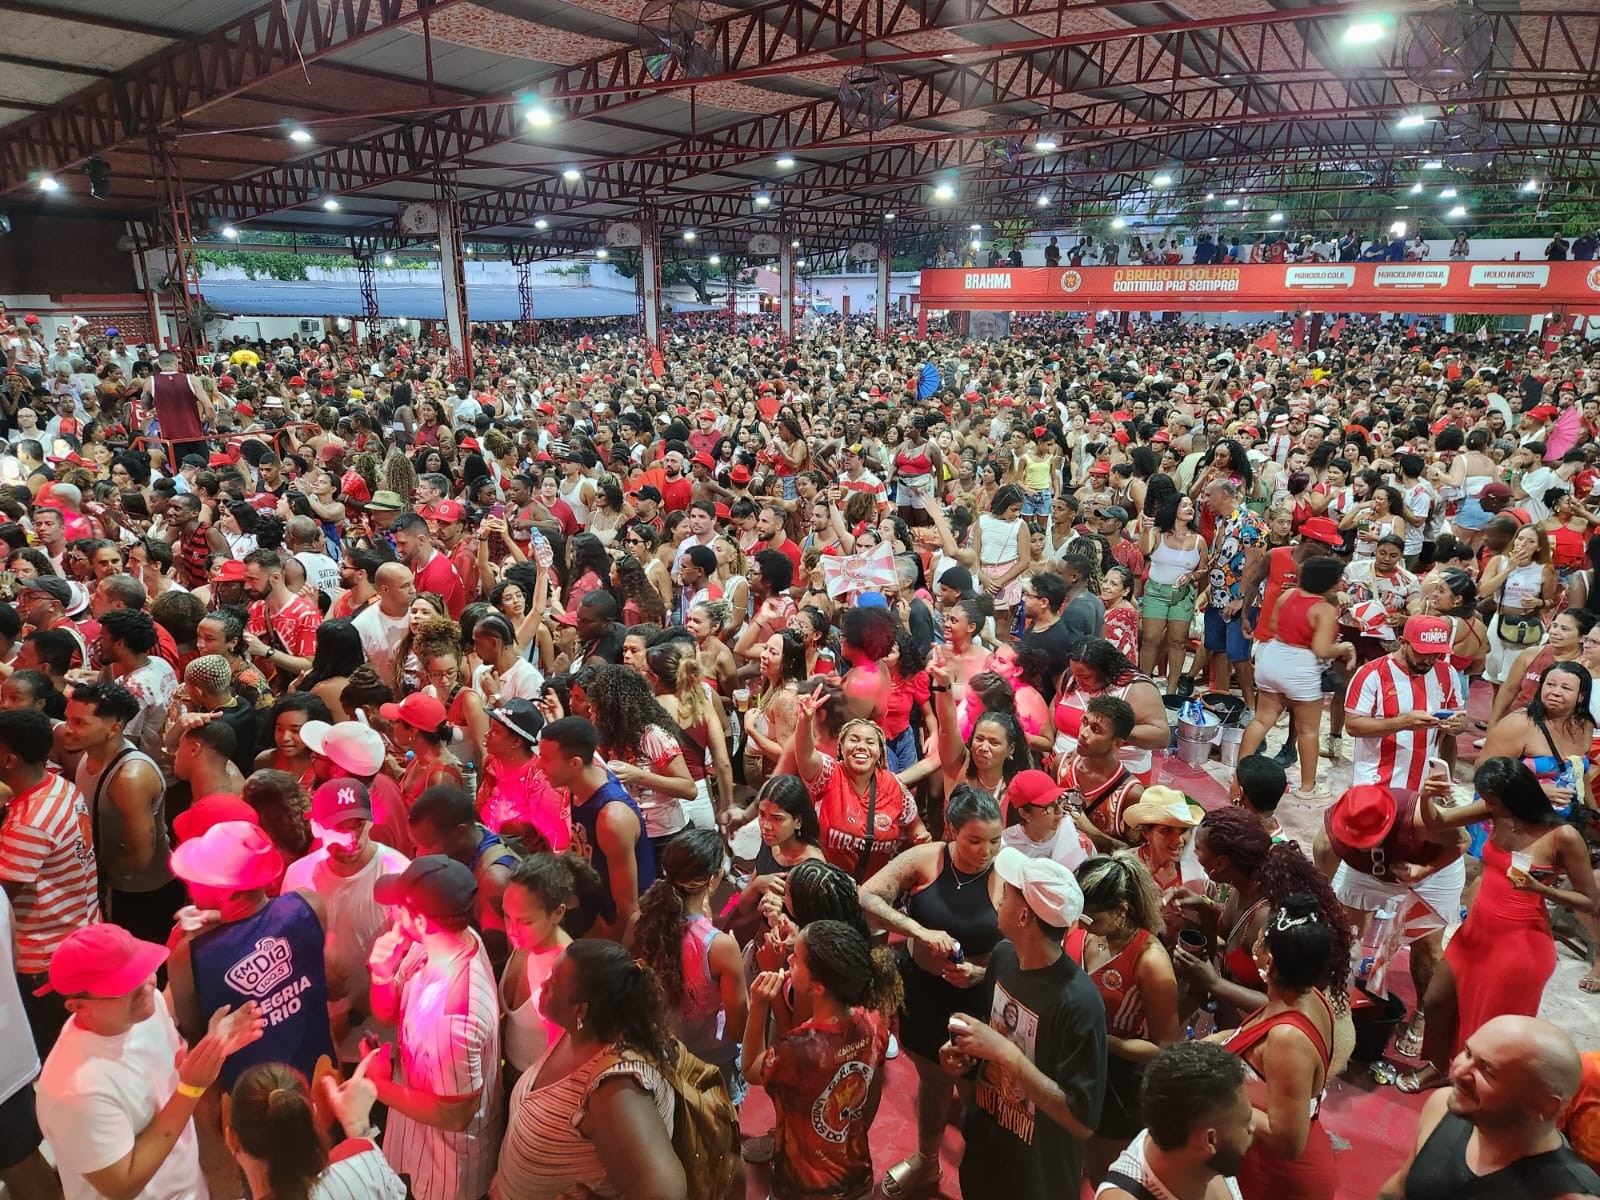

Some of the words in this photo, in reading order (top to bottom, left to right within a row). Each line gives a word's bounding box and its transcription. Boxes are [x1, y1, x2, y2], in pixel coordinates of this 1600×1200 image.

[965, 273, 1011, 289] BRAHMA
[1114, 269, 1123, 281] O
[1127, 269, 1172, 281] BRILHO
[260, 975, 312, 1015] EGRIA
[269, 997, 302, 1027] RIO
